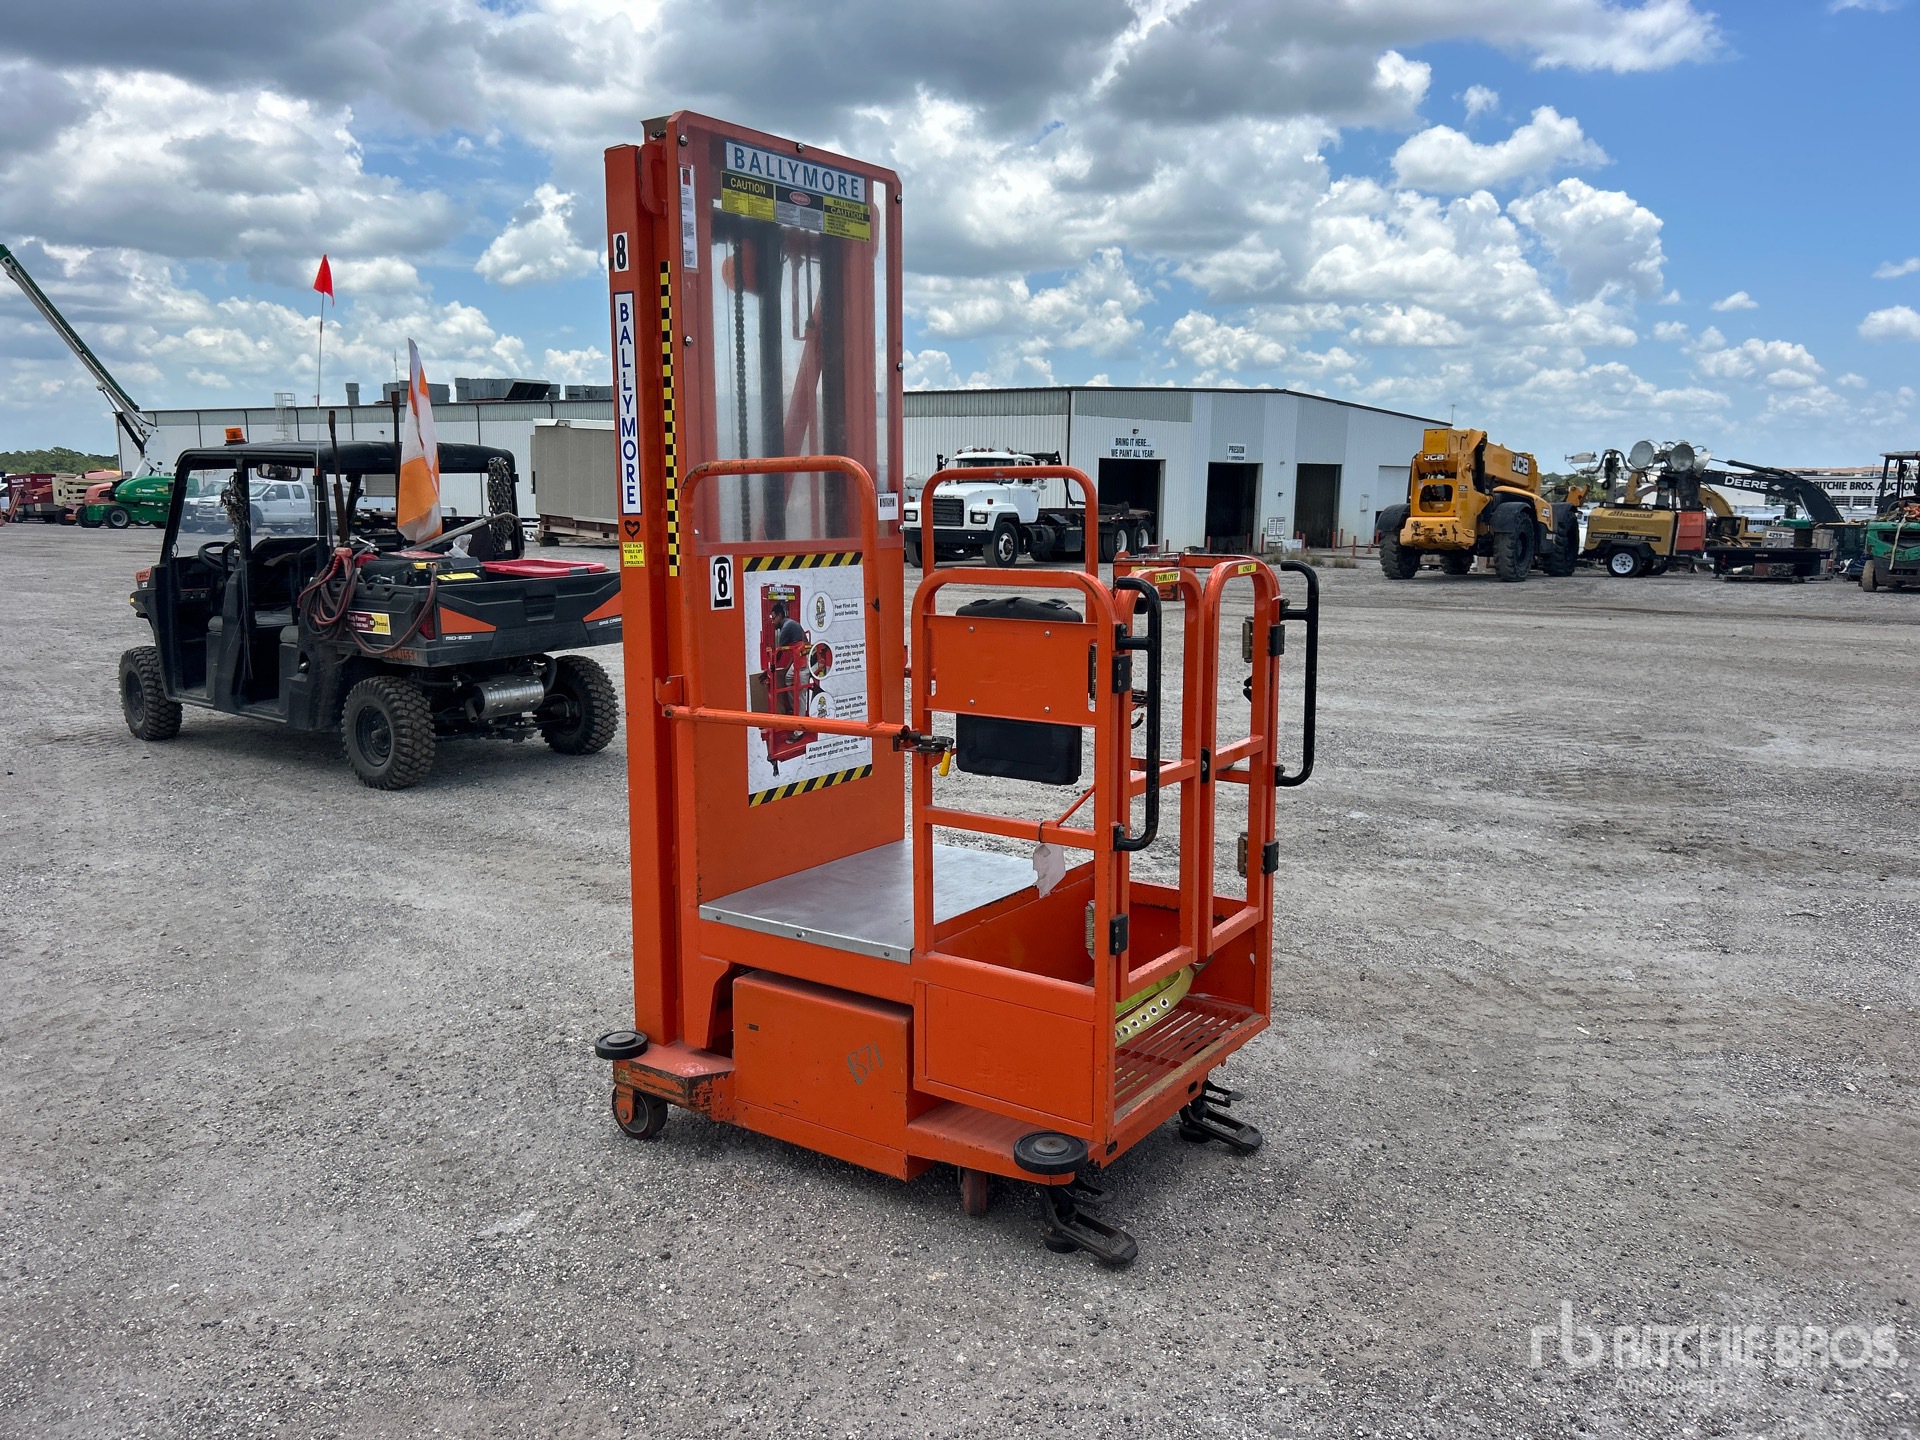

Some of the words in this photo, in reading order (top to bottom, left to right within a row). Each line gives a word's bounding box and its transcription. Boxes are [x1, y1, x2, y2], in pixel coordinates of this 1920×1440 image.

[734, 146, 859, 199] BALLYMORE
[730, 177, 766, 195] CAUTION
[831, 207, 864, 220] CAUTION
[616, 234, 626, 270] 8
[619, 302, 637, 505] BALLYMORE
[1115, 438, 1129, 446] BRING
[1130, 438, 1134, 446] IT
[1111, 449, 1118, 457] WE
[1119, 450, 1132, 458] PAINT
[1133, 450, 1141, 458] ALL
[1512, 454, 1529, 474] JCB
[1724, 476, 1769, 490] DEERE
[1850, 482, 1876, 490] BROS.
[717, 564, 728, 598] 8
